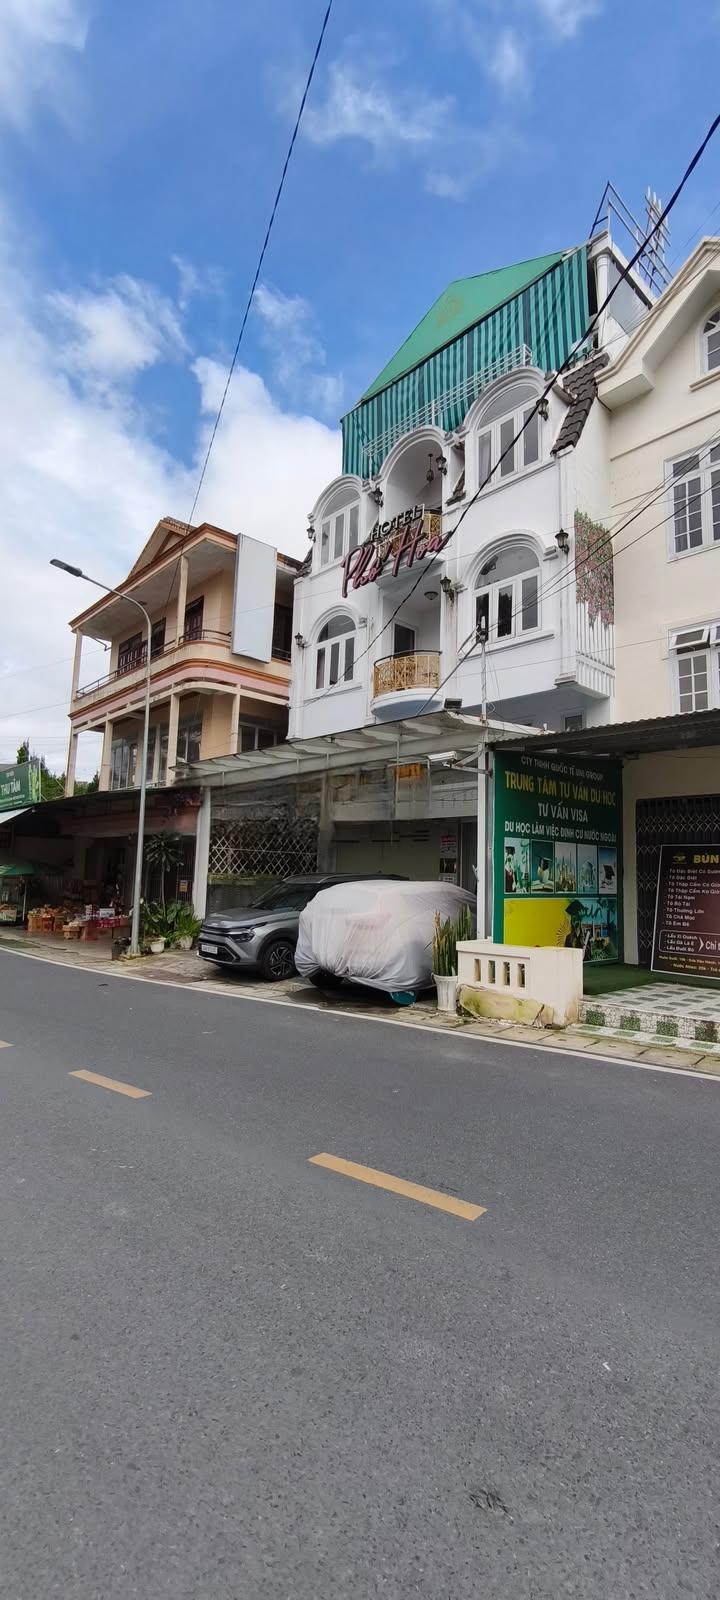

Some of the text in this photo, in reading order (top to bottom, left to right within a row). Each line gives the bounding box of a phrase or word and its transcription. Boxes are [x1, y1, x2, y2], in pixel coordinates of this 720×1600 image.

[370, 503, 425, 541] HOTEL
[391, 519, 453, 577] Hoa
[521, 756, 533, 767] CTY
[504, 770, 534, 793] TRUNG
[538, 775, 557, 797] TÂM
[538, 801, 589, 823] TƯ VẤN VISA
[504, 821, 514, 832] DU
[515, 822, 531, 836] HỌC
[532, 821, 545, 836] LÀM
[546, 823, 560, 839] VIỆC
[560, 827, 574, 841] ĐỊNH
[693, 853, 720, 864] BÚN
